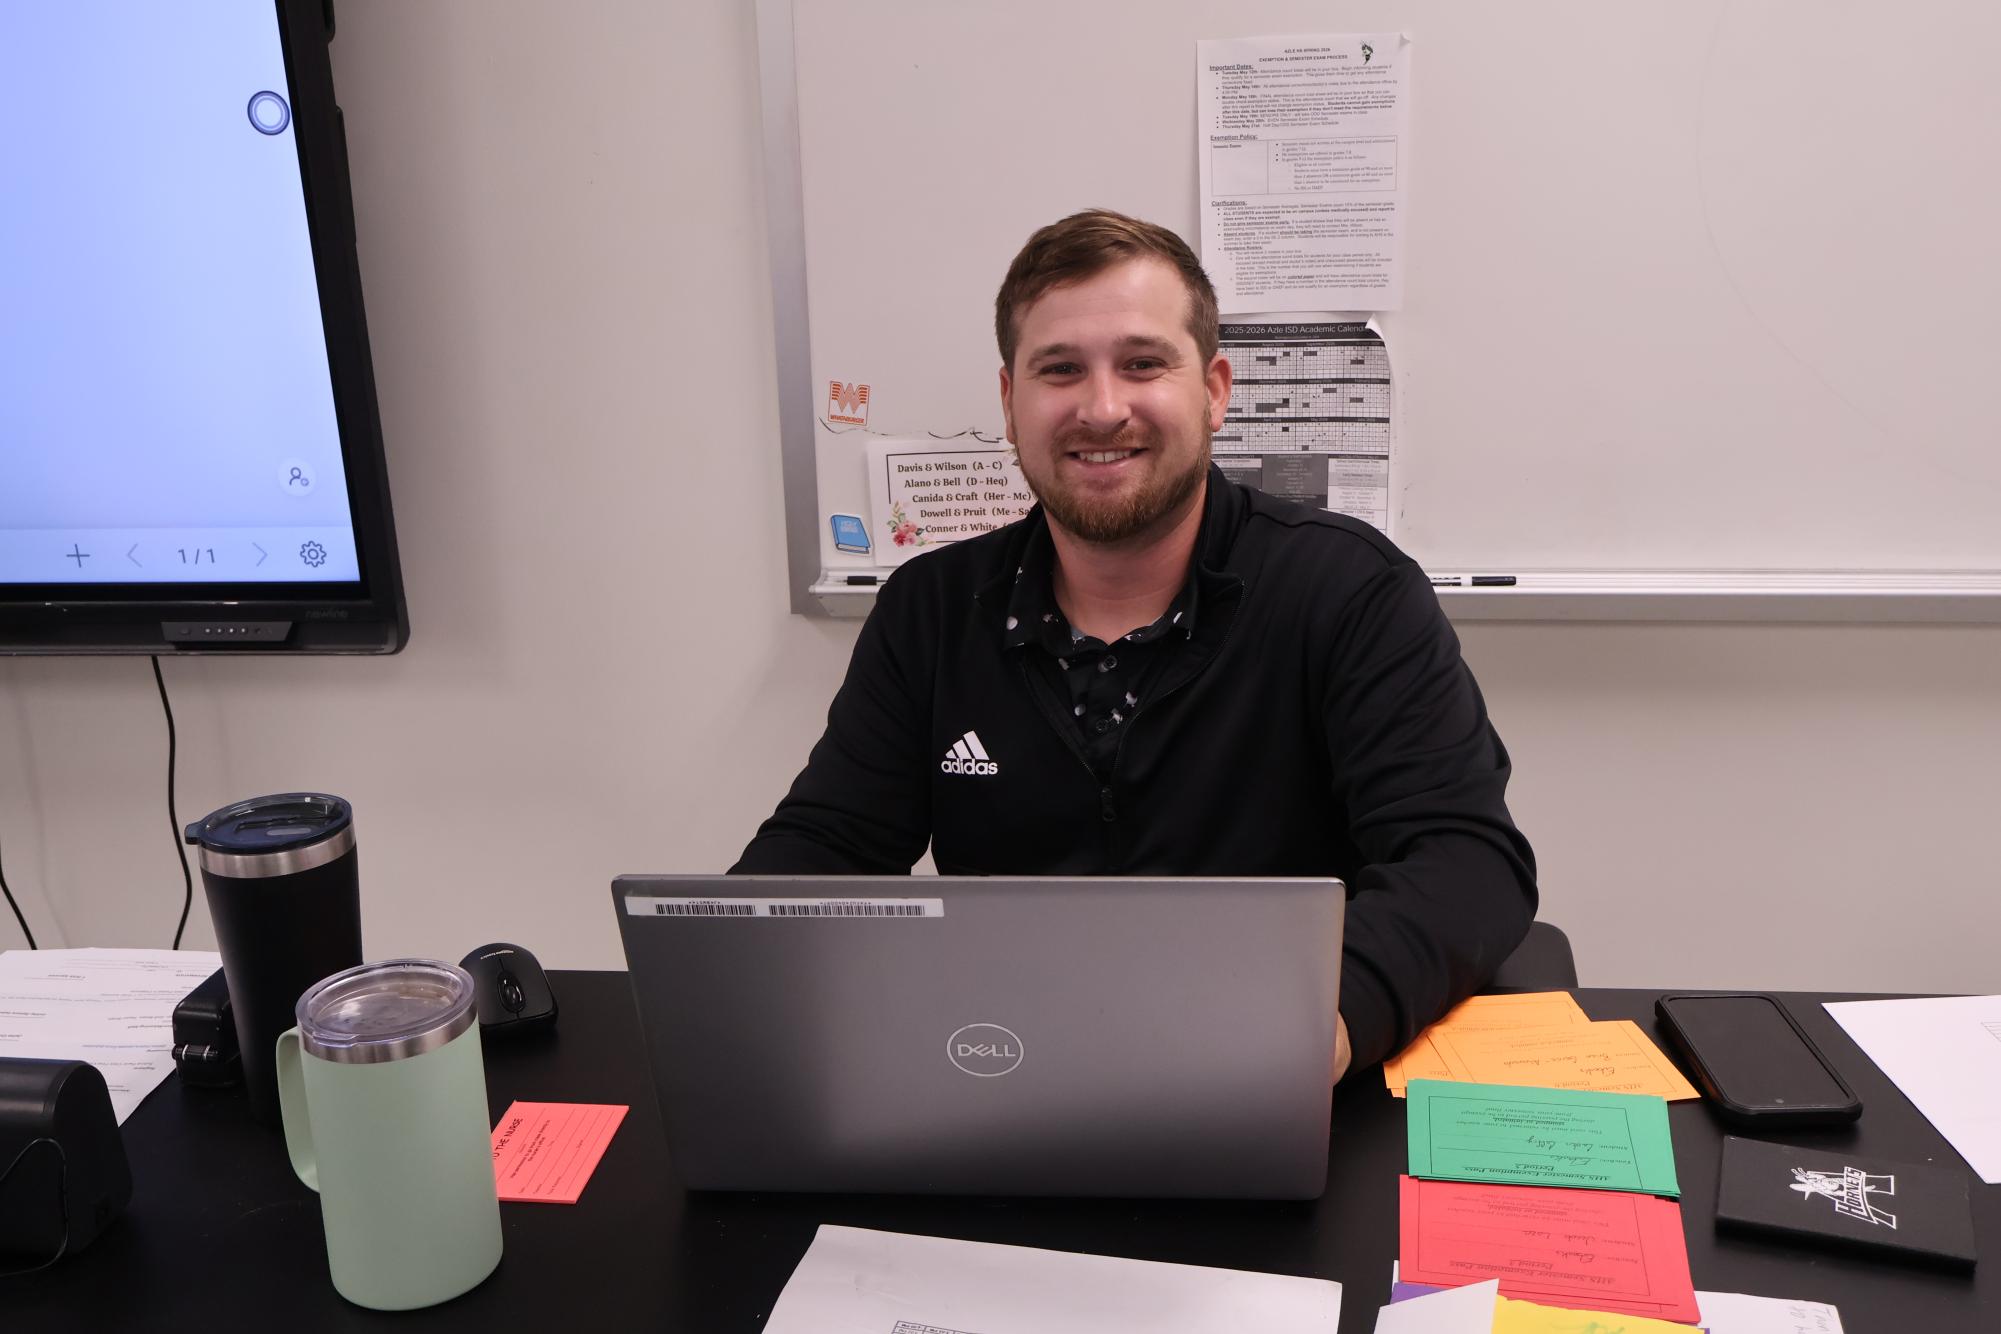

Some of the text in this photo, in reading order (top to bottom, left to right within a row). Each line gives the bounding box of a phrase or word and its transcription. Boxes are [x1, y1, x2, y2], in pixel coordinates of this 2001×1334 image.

[1210, 64, 1236, 72] Important
[1224, 324, 1365, 334] 2025-2026 Azle ISD Academic Calend
[897, 463, 923, 473] Davis
[925, 463, 933, 472] &
[934, 462, 967, 472] Wilson
[972, 461, 984, 472] (A
[992, 460, 1003, 470] C)
[904, 479, 931, 488] Alano
[933, 478, 942, 487] &
[943, 477, 961, 486] Bell
[966, 477, 978, 487] (D
[986, 476, 1008, 486] Heq)
[912, 493, 943, 503] Canida
[946, 493, 953, 501] &
[955, 492, 978, 501] Craft
[984, 492, 1005, 502] (Her
[1013, 492, 1031, 501] Mc)
[920, 508, 952, 518] Dowell
[954, 508, 961, 516] &
[963, 507, 986, 516] Pruit
[992, 506, 1010, 516] (Me
[925, 524, 957, 533] Conner
[960, 523, 968, 531] &
[970, 522, 997, 532] White
[941, 758, 998, 775] adidas
[958, 1044, 1016, 1057] DELL
[494, 1118, 524, 1151] THE NURSE
[1524, 1164, 1554, 1172] Period
[1518, 1260, 1553, 1270] Period
[1538, 1272, 1585, 1282] Semester
